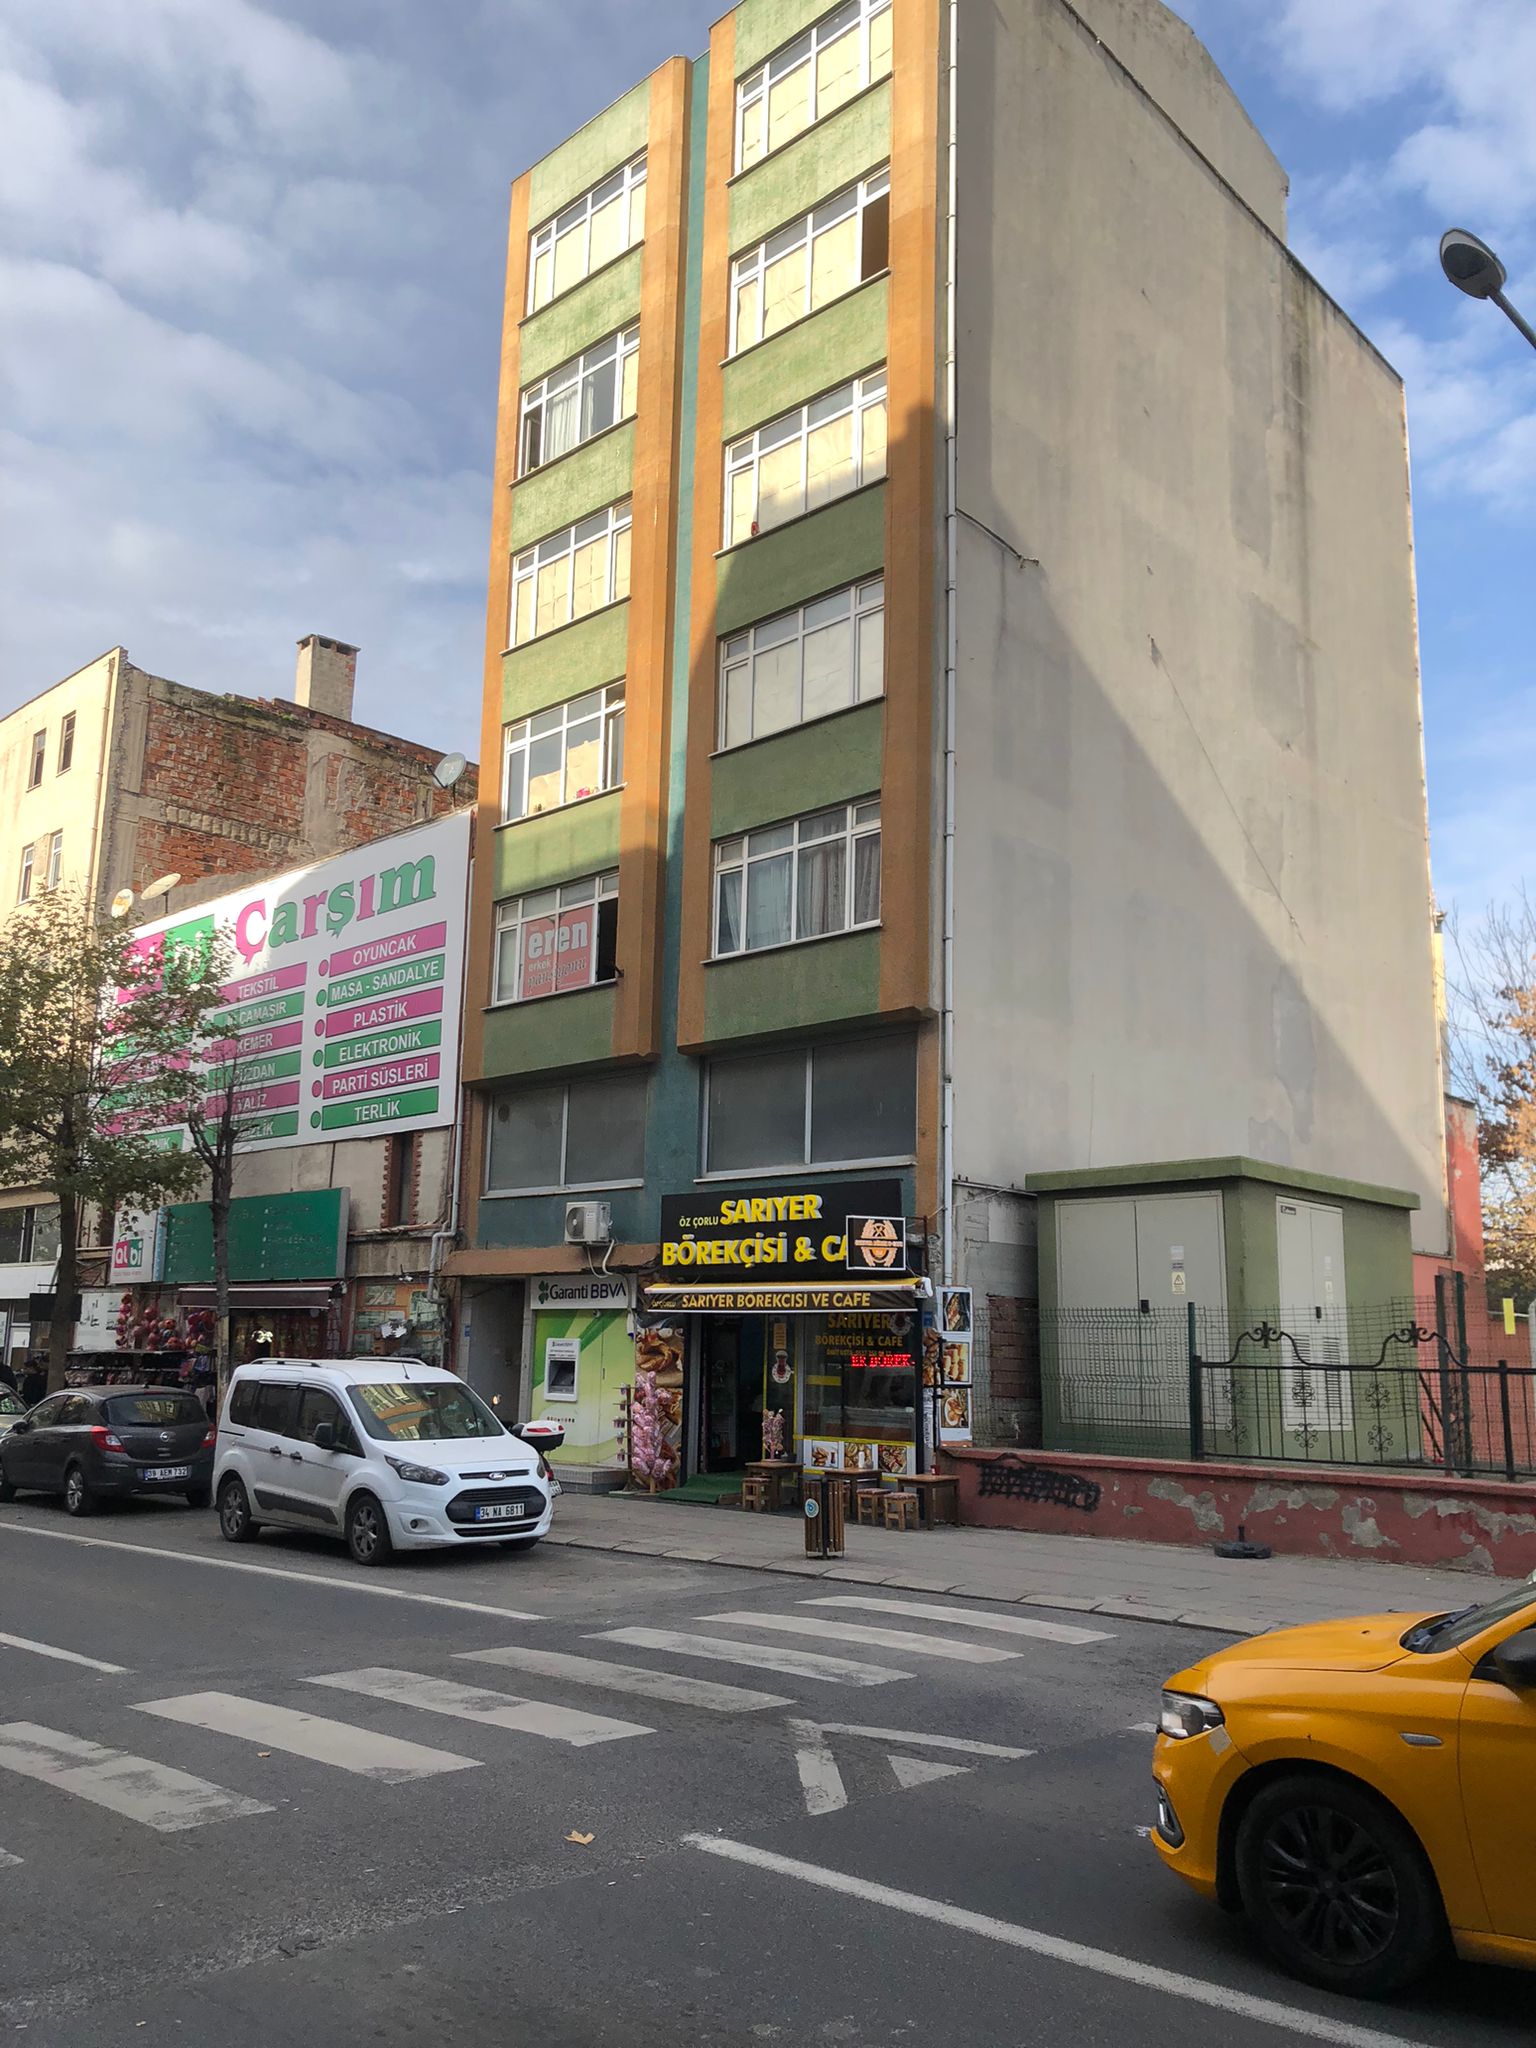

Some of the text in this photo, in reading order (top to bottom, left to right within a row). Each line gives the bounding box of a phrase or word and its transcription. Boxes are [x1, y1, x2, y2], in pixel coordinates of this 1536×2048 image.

[235, 855, 436, 966] Çarşım
[353, 935, 417, 965] OYUNCAK
[528, 922, 588, 959] eren
[238, 974, 279, 998] TEKSTİL
[331, 981, 363, 1001] MASA
[373, 960, 440, 990] SANDALYE
[354, 1000, 408, 1028] PLASTİK
[237, 1033, 273, 1052] KEMER
[340, 1029, 422, 1062] ELEKTRONİK
[332, 1058, 429, 1094] PARTİ SÜSLERİ
[355, 1098, 400, 1122] TERLİK
[679, 1194, 822, 1229] ÖZ ÇORLU SARIYER
[662, 1232, 787, 1268] BÖREKÇİSİ
[794, 1236, 817, 1262] &
[549, 1283, 626, 1299] Garanti BBVA
[682, 1294, 733, 1308] SARIYER
[812, 1293, 829, 1307] VE
[833, 1292, 871, 1307] CAFE
[828, 1312, 892, 1329] SARIYER
[878, 1336, 903, 1347] CAFE
[480, 1507, 490, 1518] 34
[505, 1504, 523, 1516] 6811
